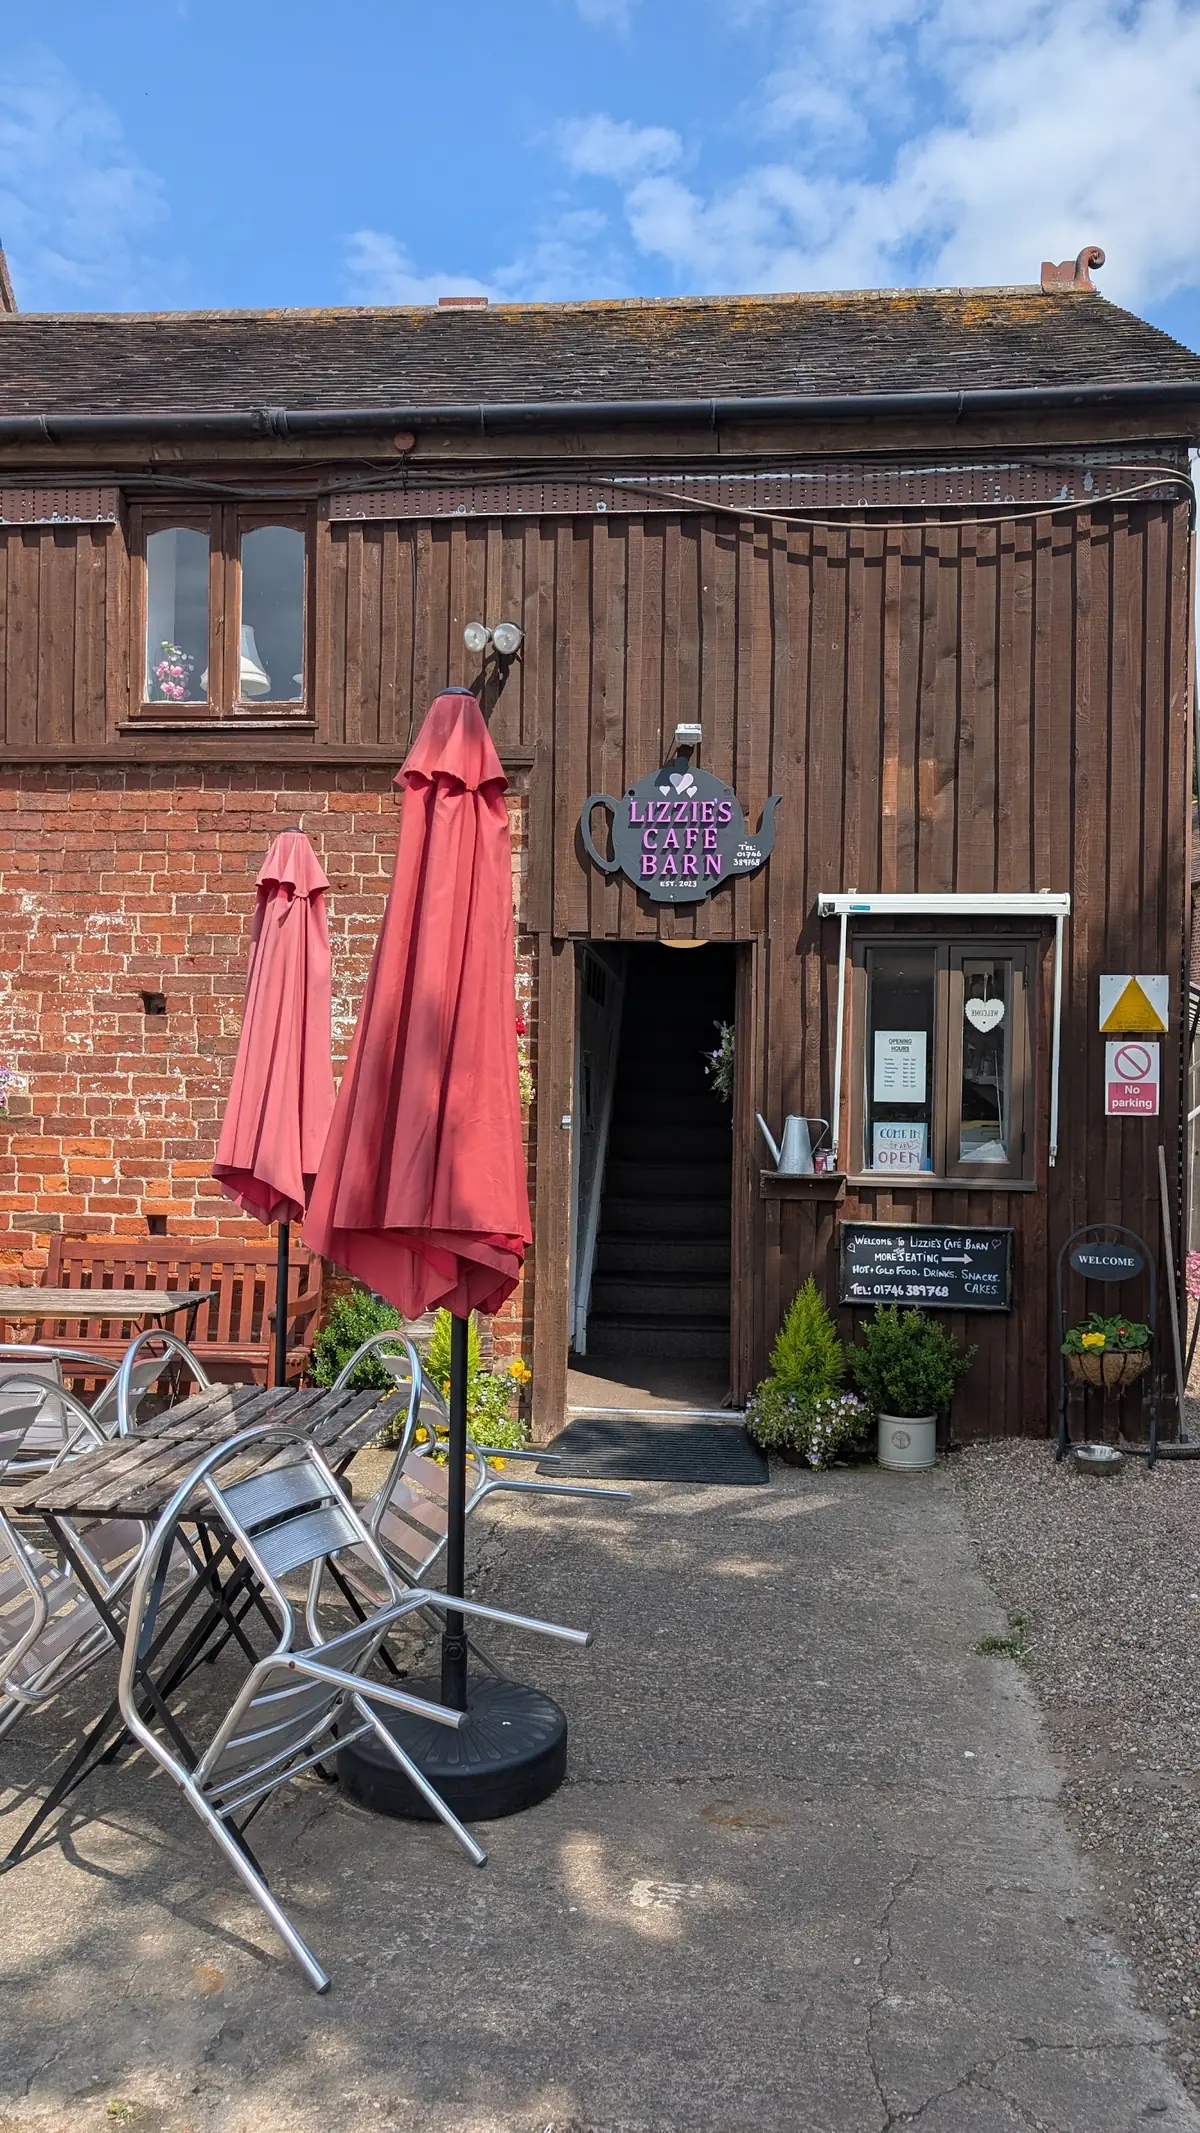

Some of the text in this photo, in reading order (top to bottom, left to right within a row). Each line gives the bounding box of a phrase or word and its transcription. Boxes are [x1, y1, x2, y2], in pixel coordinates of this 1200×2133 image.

[629, 799, 732, 823] LIZZIE'S
[643, 825, 718, 849] CAFÉ
[736, 850, 762, 859] 01746
[641, 854, 722, 875] BARN
[659, 880, 698, 888] EST. 2023
[888, 1038, 913, 1046] OPENING
[890, 1045, 910, 1053] HOURS
[1124, 1085, 1141, 1095] No
[1111, 1098, 1153, 1110] parking
[880, 1128, 921, 1139] COME IN
[878, 1151, 920, 1165] OPEN
[874, 1253, 897, 1262] MORE
[1077, 1255, 1135, 1267] WELCOME
[873, 1284, 904, 1297] 01746
[905, 1284, 949, 1297] 389768
